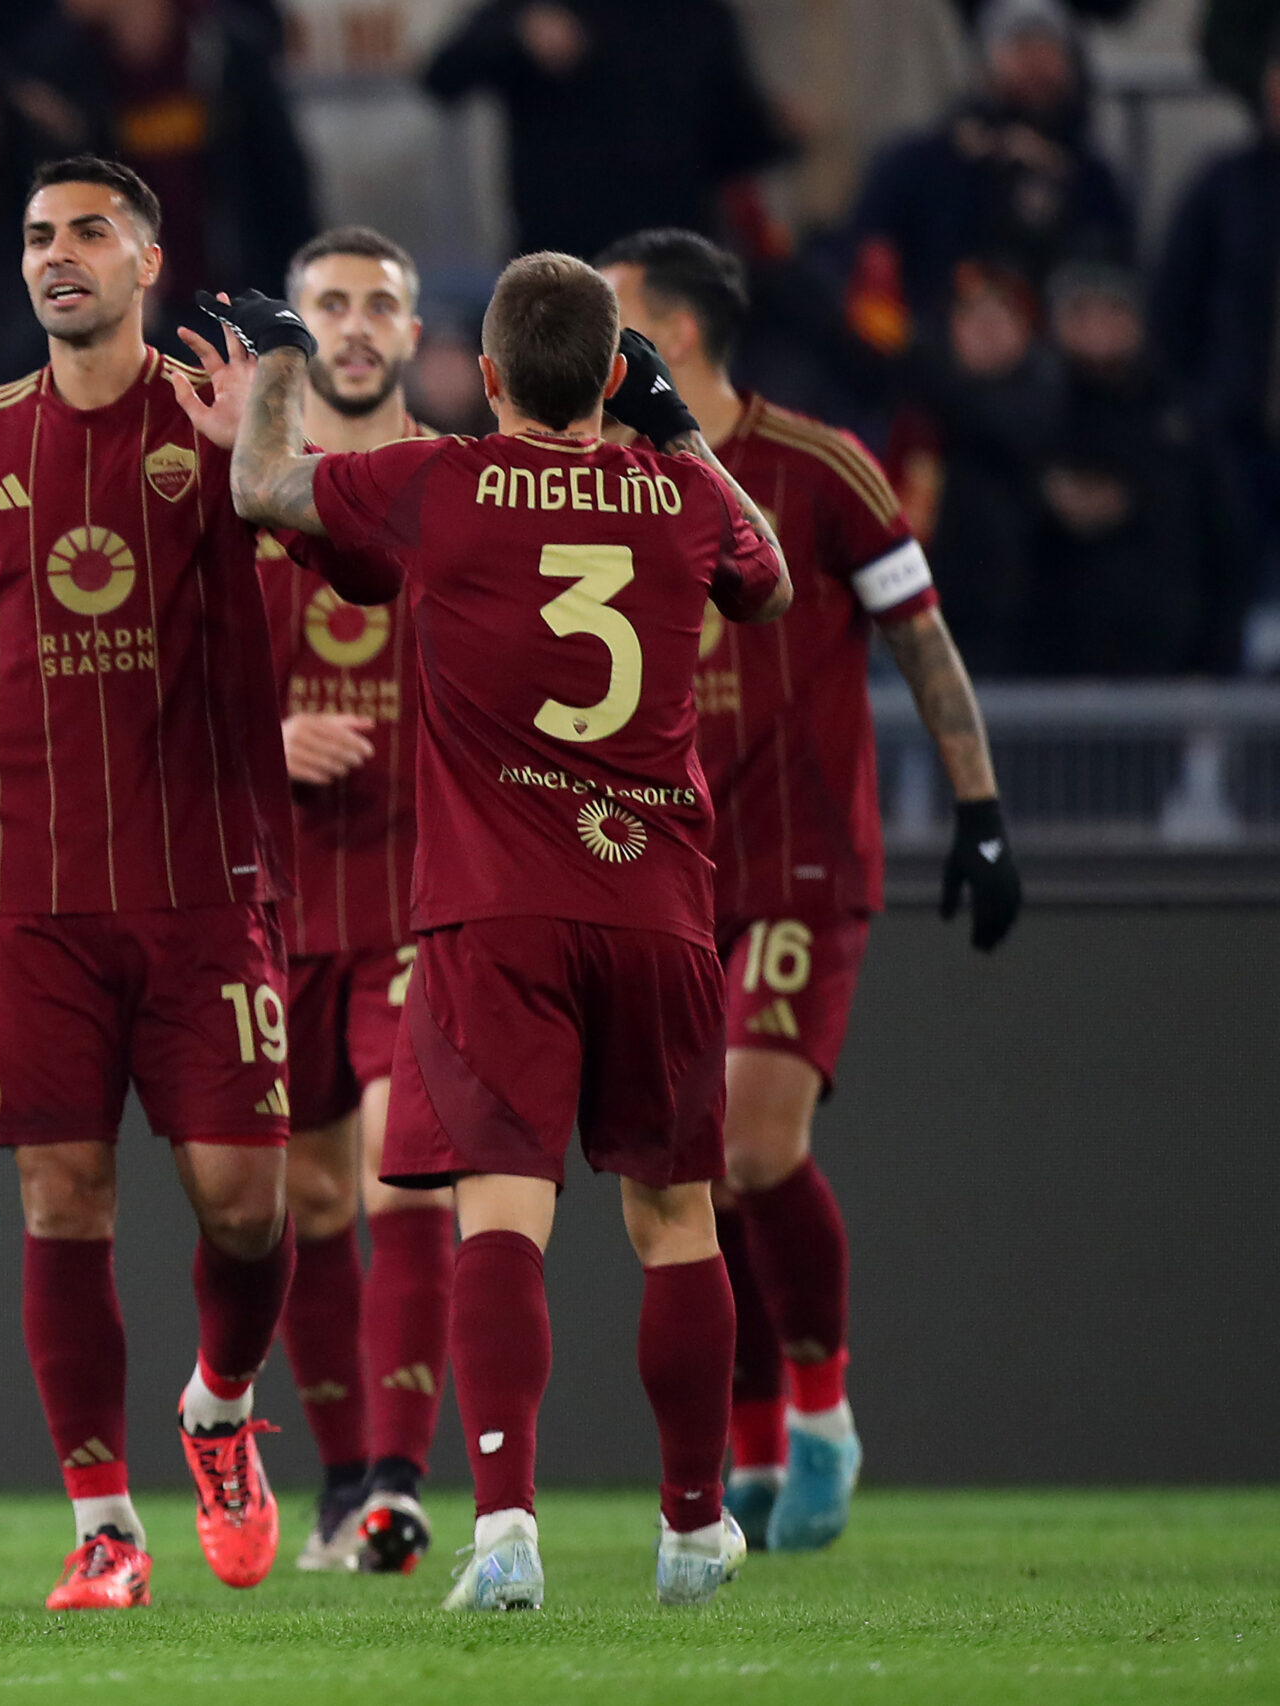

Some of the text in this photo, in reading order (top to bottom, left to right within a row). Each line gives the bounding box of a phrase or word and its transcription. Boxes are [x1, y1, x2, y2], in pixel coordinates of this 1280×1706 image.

[476, 464, 683, 516] ANGELIÑO
[41, 627, 154, 654] RIYADH
[43, 650, 156, 677] SEASON
[533, 543, 643, 743] 3
[742, 918, 814, 993] 16
[221, 982, 288, 1064] 19
